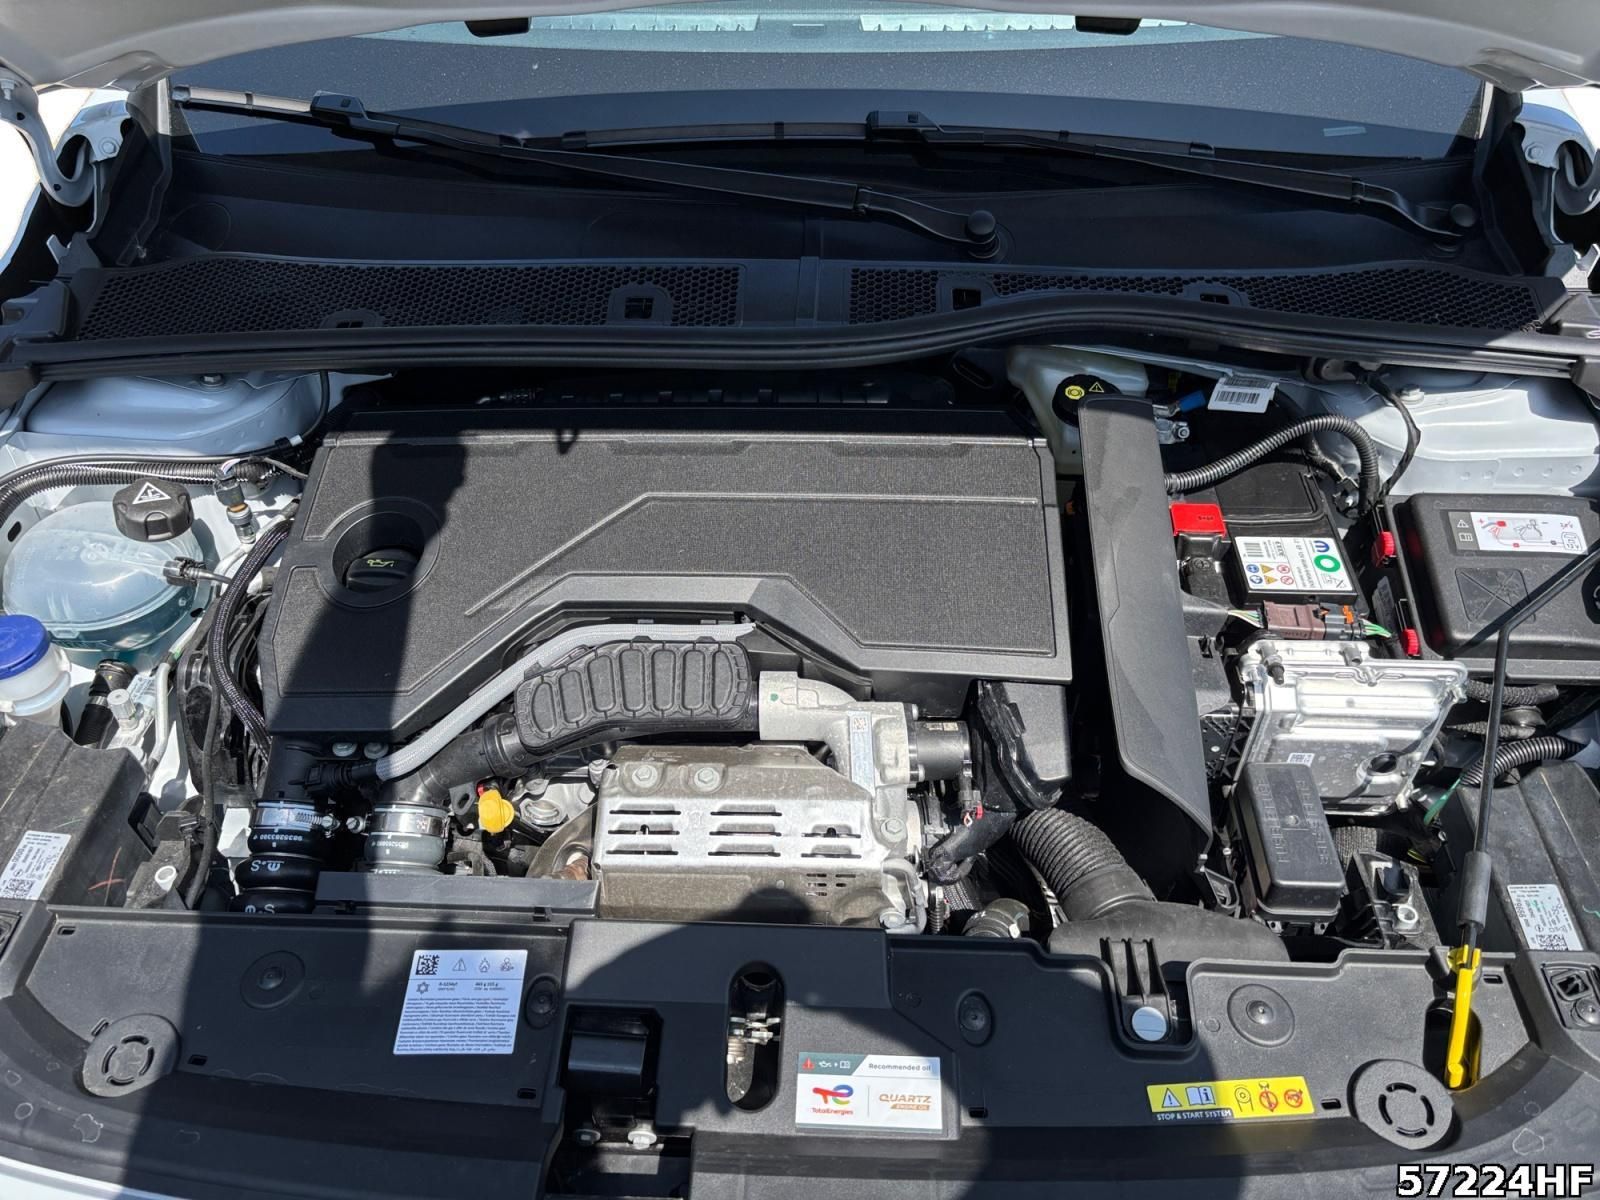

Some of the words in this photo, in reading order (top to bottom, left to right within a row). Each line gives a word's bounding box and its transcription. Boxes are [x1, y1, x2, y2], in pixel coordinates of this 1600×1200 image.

[868, 1063, 921, 1072] Recommended
[879, 1093, 932, 1104] QUARTZ
[812, 1107, 854, 1116] TotalEnergies
[1156, 1112, 1176, 1121] STOP
[1176, 1112, 1182, 1120] &
[1182, 1111, 1204, 1120] START
[1205, 1109, 1232, 1119] SYSTEM
